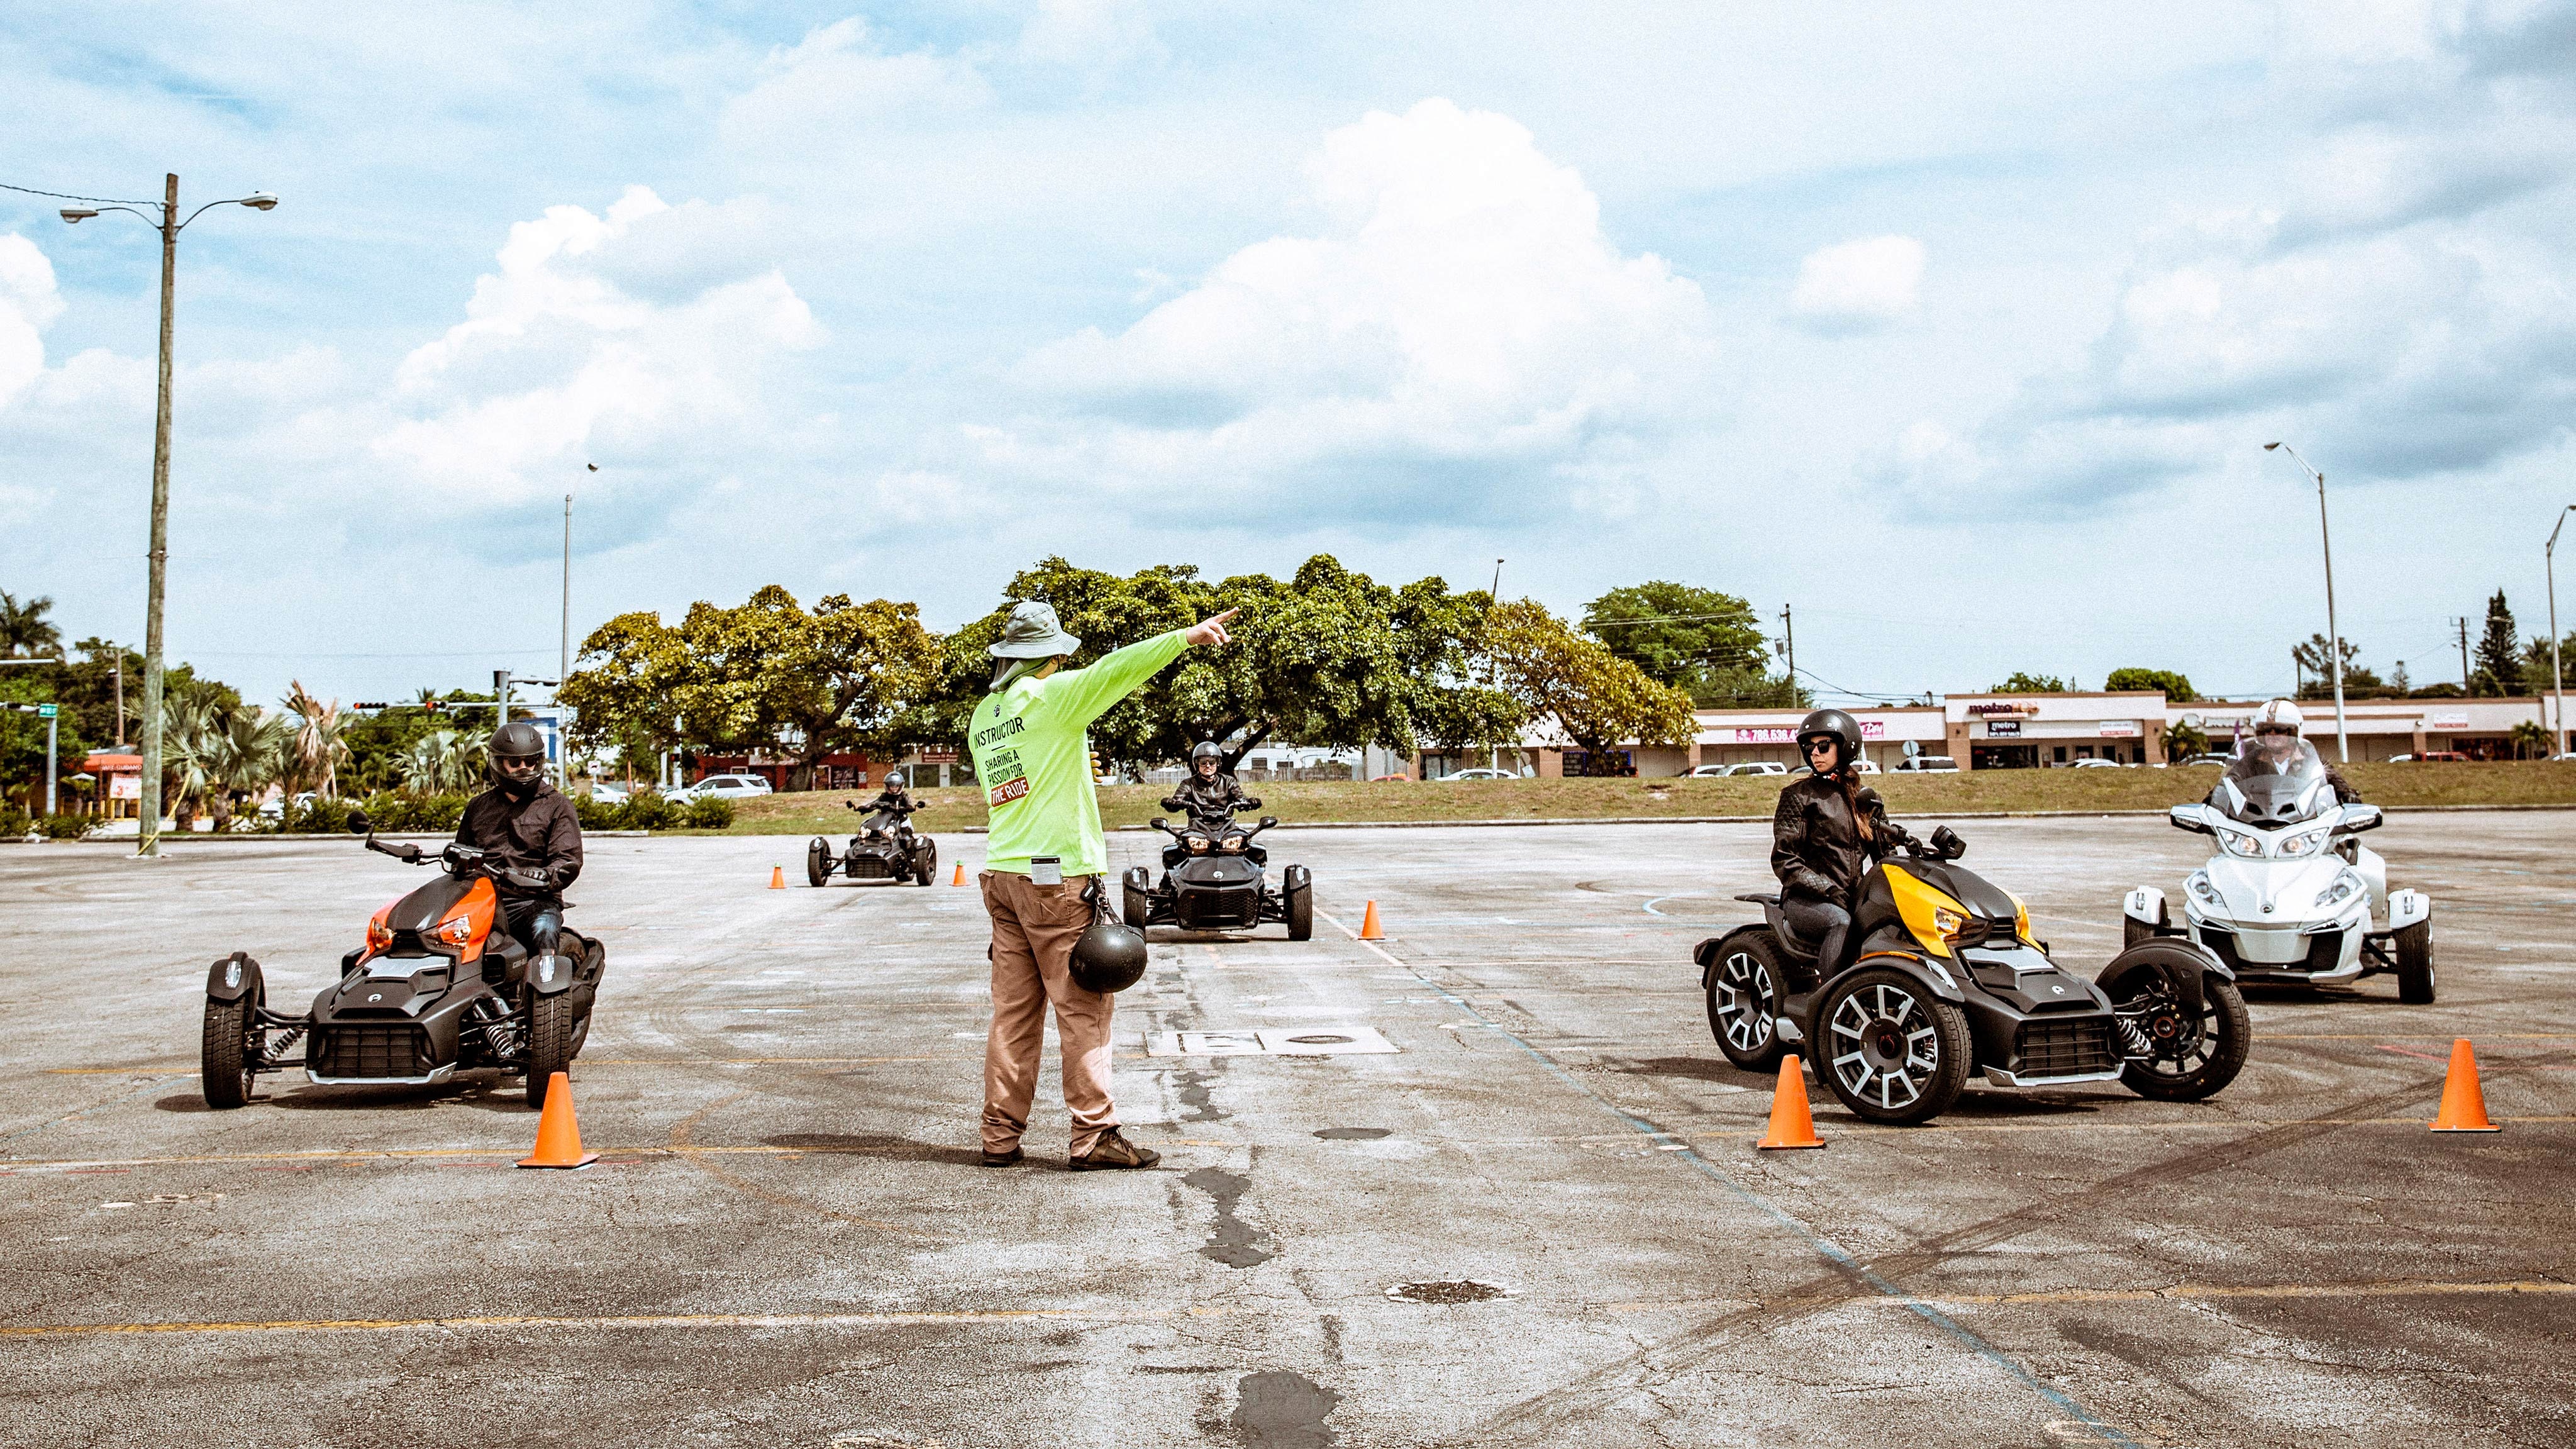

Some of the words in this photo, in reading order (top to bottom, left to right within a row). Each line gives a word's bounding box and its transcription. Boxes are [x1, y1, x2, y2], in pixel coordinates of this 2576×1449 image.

[974, 717, 1025, 749] INSTRUCTOR
[1991, 722, 2016, 730] metro
[985, 751, 1013, 772] SHARING
[1013, 749, 1019, 761] A
[987, 767, 1011, 787] PASSION
[1010, 763, 1024, 779] FOR
[991, 787, 1007, 805] THE
[1004, 779, 1030, 799] RIDE
